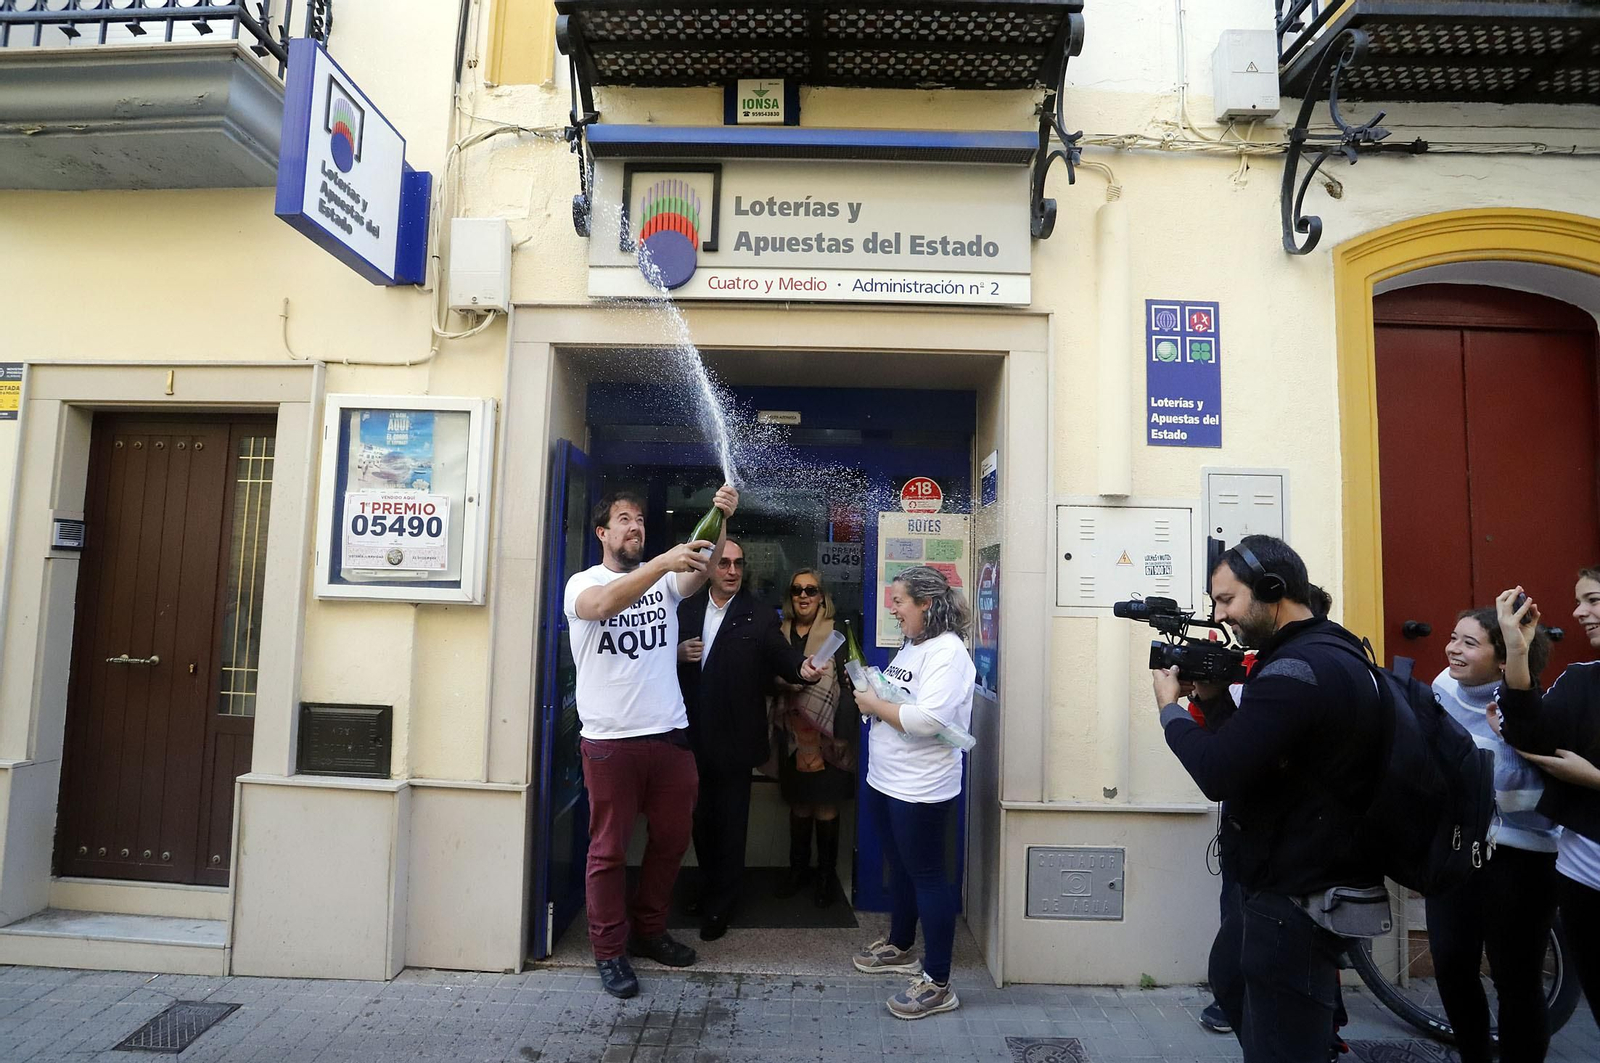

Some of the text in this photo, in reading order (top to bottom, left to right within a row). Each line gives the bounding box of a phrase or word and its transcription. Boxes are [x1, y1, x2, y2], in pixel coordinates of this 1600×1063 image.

[742, 98, 780, 110] IONSA
[320, 160, 369, 214] Loterías y
[318, 197, 353, 235] Estado
[320, 180, 380, 239] Apuestas del
[734, 195, 862, 223] Loterías y
[733, 231, 1000, 258] Apuestas del Estado
[708, 276, 759, 291] Cuatro
[764, 280, 774, 294] y
[779, 277, 828, 292] Medio
[852, 278, 965, 296] Administración
[990, 282, 1000, 296] 2
[1150, 397, 1204, 411] Loterías y
[1150, 413, 1219, 426] Apuestas del
[1151, 429, 1188, 440] Estado
[909, 482, 932, 496] +18
[371, 501, 436, 516] PREMIO
[351, 514, 443, 538] 05490
[908, 519, 941, 533] BOTES
[821, 553, 860, 566] 0549
[597, 621, 667, 660] AQUÍ
[1038, 853, 1115, 869] CONTADOR
[1042, 898, 1109, 913] DE AGUA
